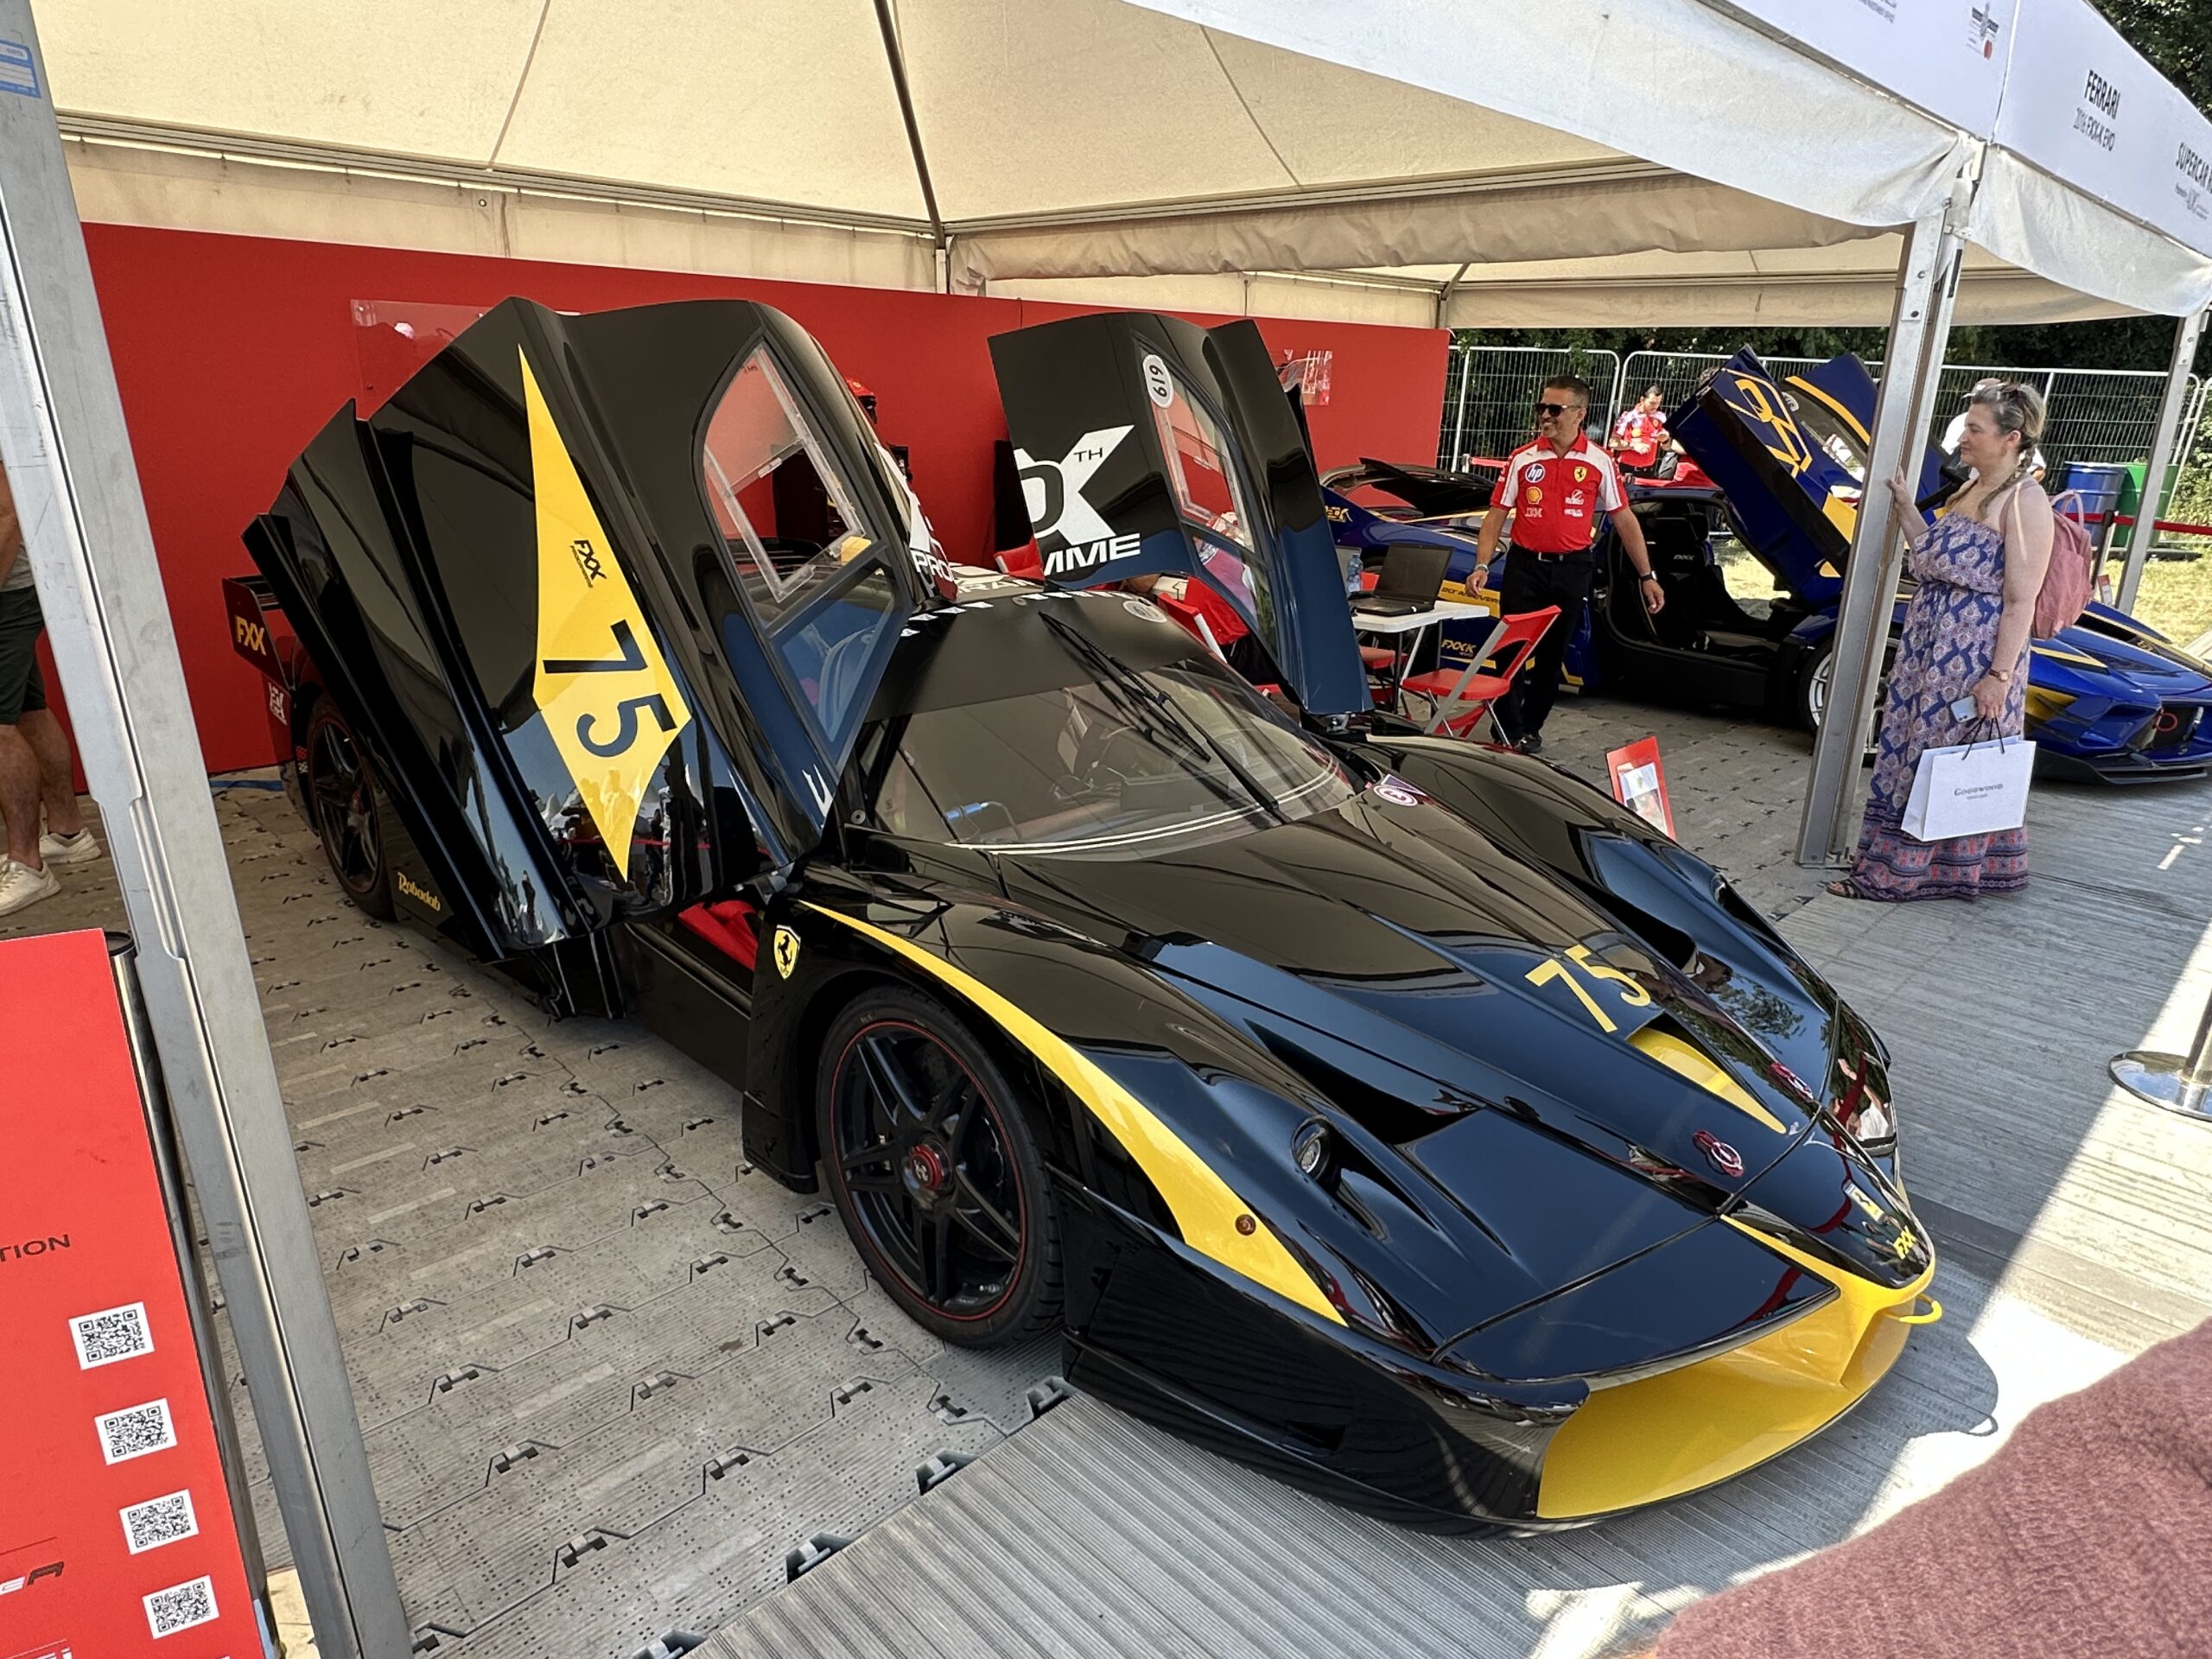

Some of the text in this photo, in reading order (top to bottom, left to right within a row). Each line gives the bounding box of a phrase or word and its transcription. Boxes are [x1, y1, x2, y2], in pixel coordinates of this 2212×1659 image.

[2084, 69, 2121, 119] FERRARI
[1149, 365, 1167, 397] 619
[1527, 467, 1543, 482] hp
[573, 540, 607, 581] FXX
[234, 615, 266, 656] FXX
[543, 619, 678, 758] 75
[1524, 944, 1651, 1033] 75
